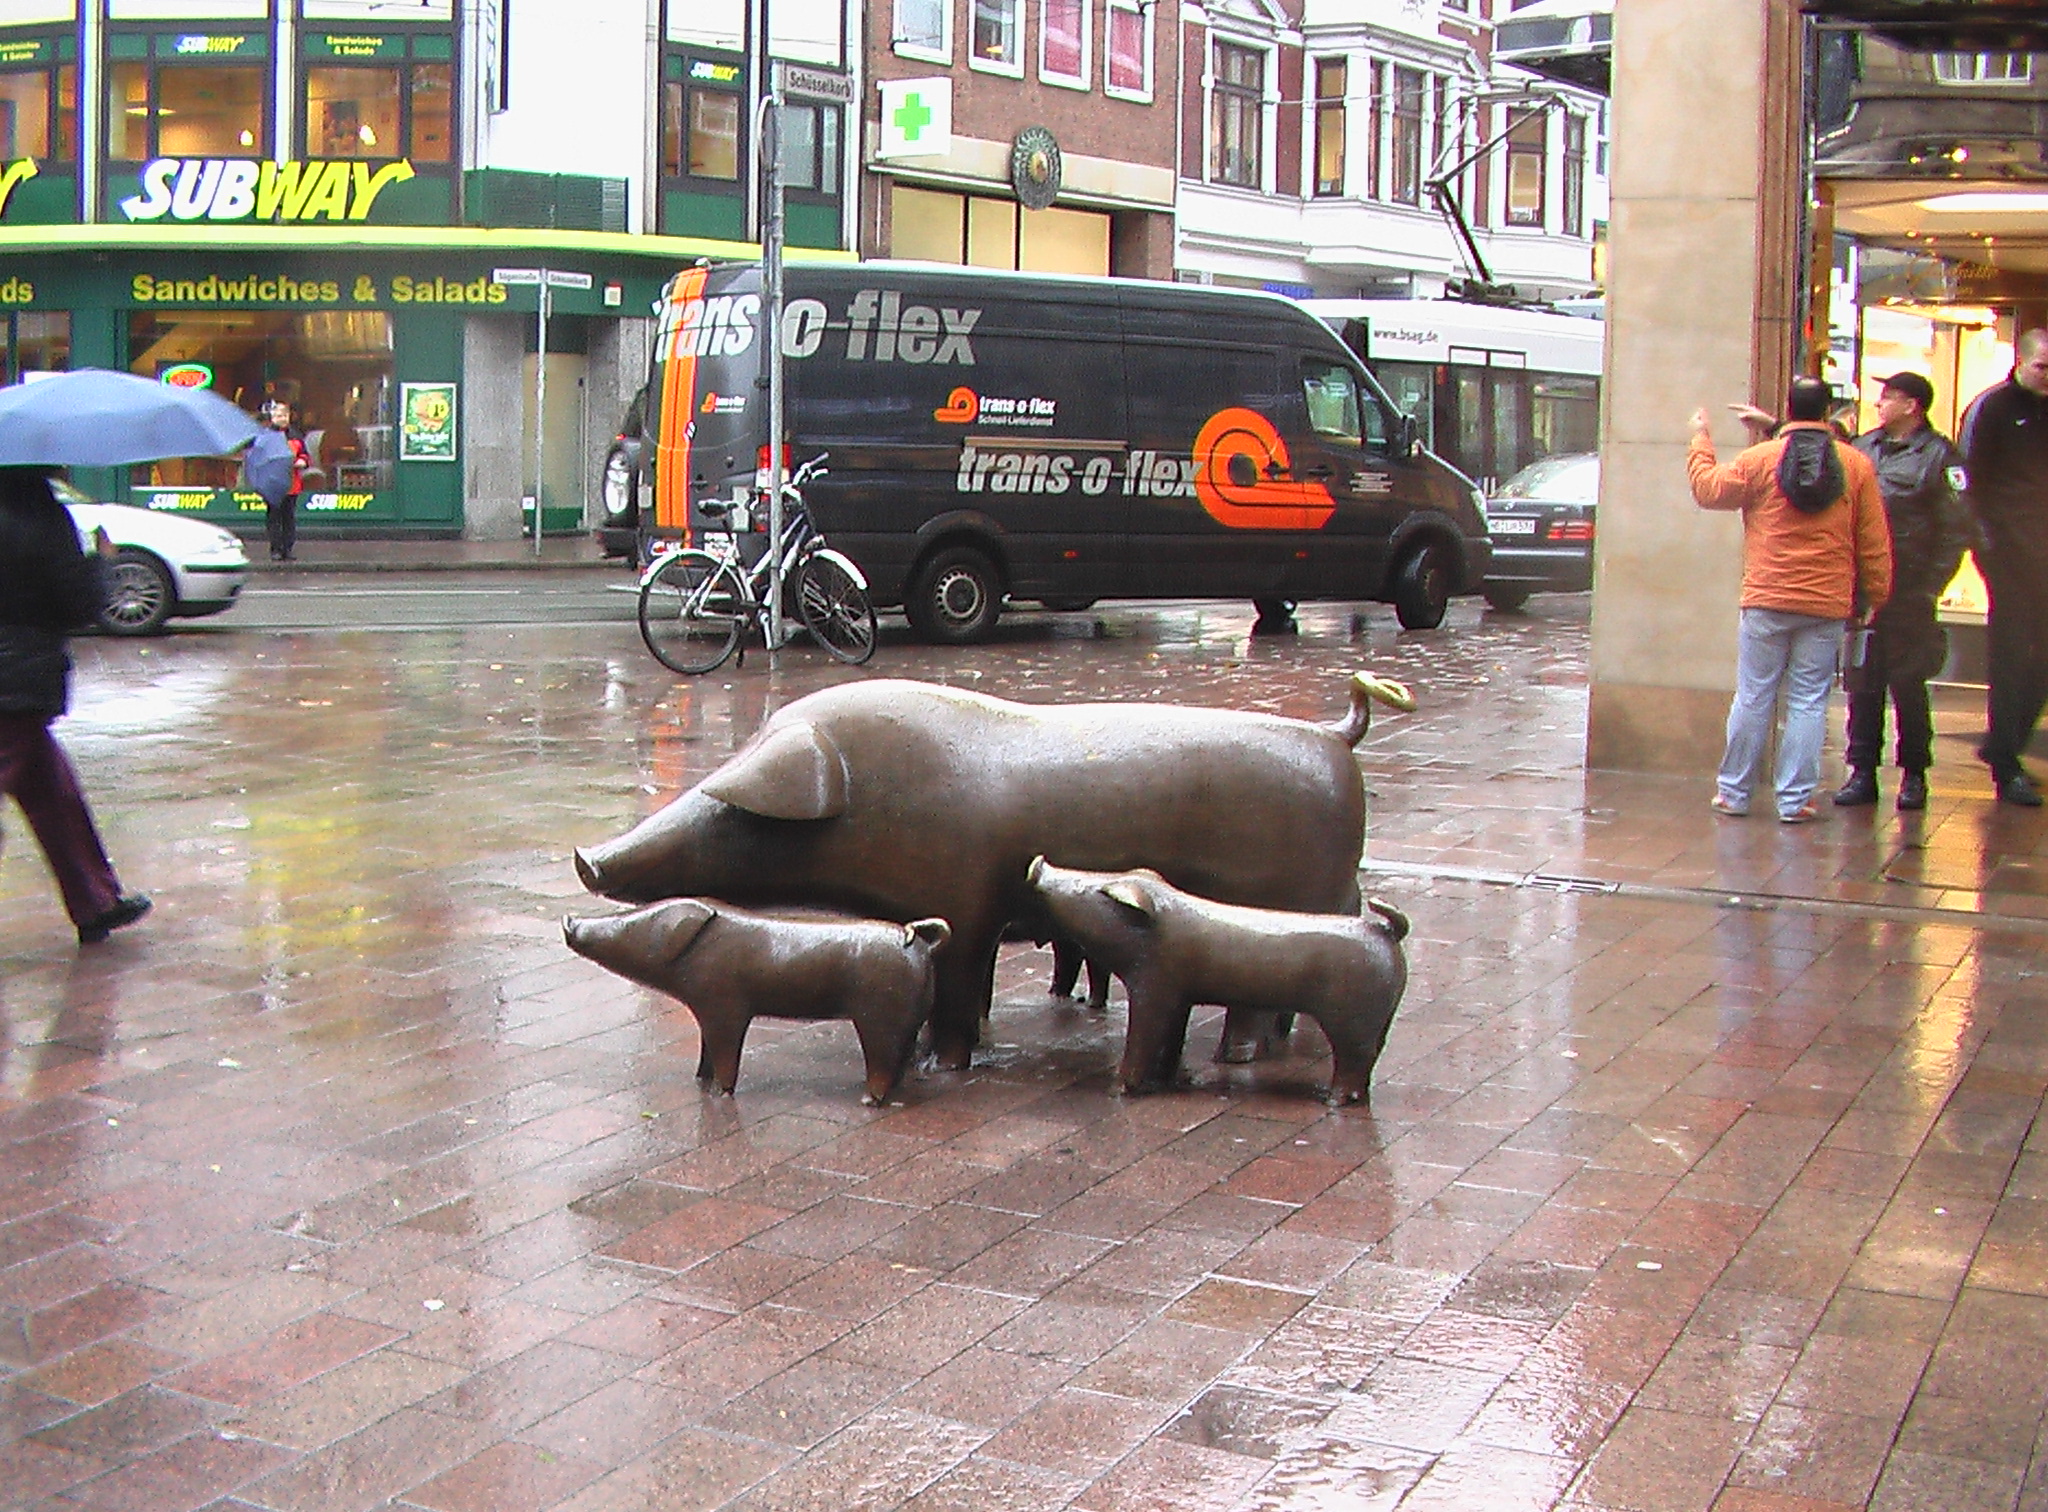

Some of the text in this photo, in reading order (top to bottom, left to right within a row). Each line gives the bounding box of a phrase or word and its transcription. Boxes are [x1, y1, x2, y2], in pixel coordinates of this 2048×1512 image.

[175, 35, 244, 53] SUBWAY
[789, 70, 851, 97] Schüsselkorb
[121, 158, 416, 221] SUBWAY
[132, 275, 508, 303] Sandwiches & Salads
[149, 493, 215, 510] SUBWAY
[306, 493, 373, 510] SUBWAY
